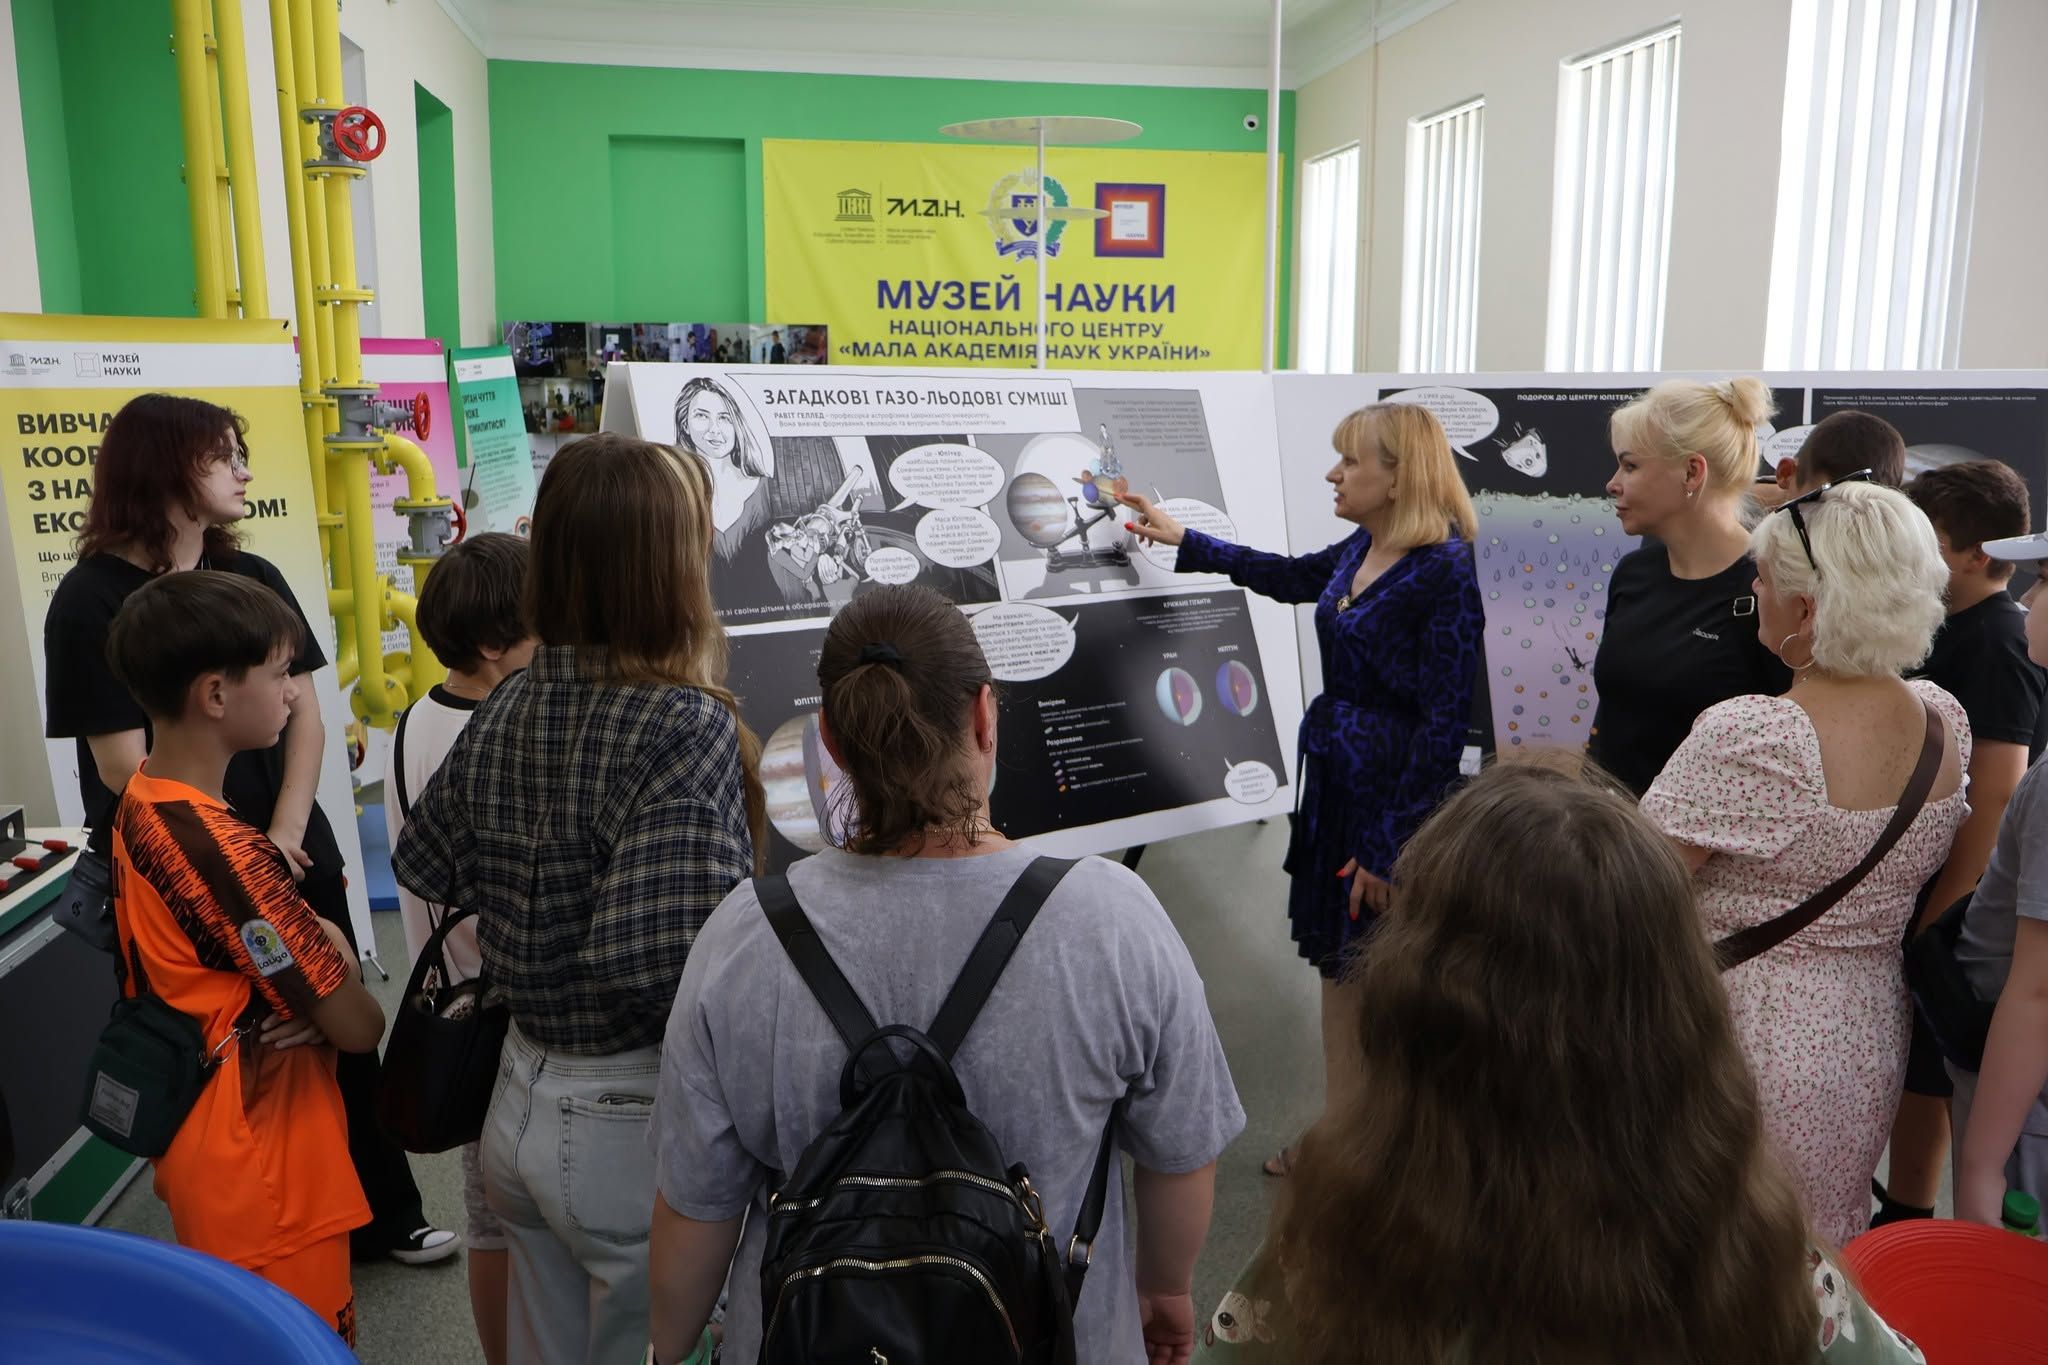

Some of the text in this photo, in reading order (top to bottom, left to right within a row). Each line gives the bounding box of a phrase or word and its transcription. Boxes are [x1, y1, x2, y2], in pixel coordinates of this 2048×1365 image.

[877, 275, 1021, 312] МУЗЕЙ
[1082, 322, 1164, 340] ЦЕНТРУ
[102, 352, 140, 364] МУЗЕЙ
[839, 341, 1211, 363] «МАЛА АКАДЕМІЯ НАУК УКРАЇНИ»
[104, 367, 142, 376] НАУКИ
[763, 389, 1068, 408] ЗАГАДКОВІ ГАЗО-ЛЬОДОВІ СУМІШІ
[1516, 394, 1555, 402] ПОДОРОЖ
[1555, 394, 1568, 402] ДО
[1568, 394, 1599, 402] ЦЕНТРУ
[27, 479, 47, 501] З
[38, 551, 60, 563] Що
